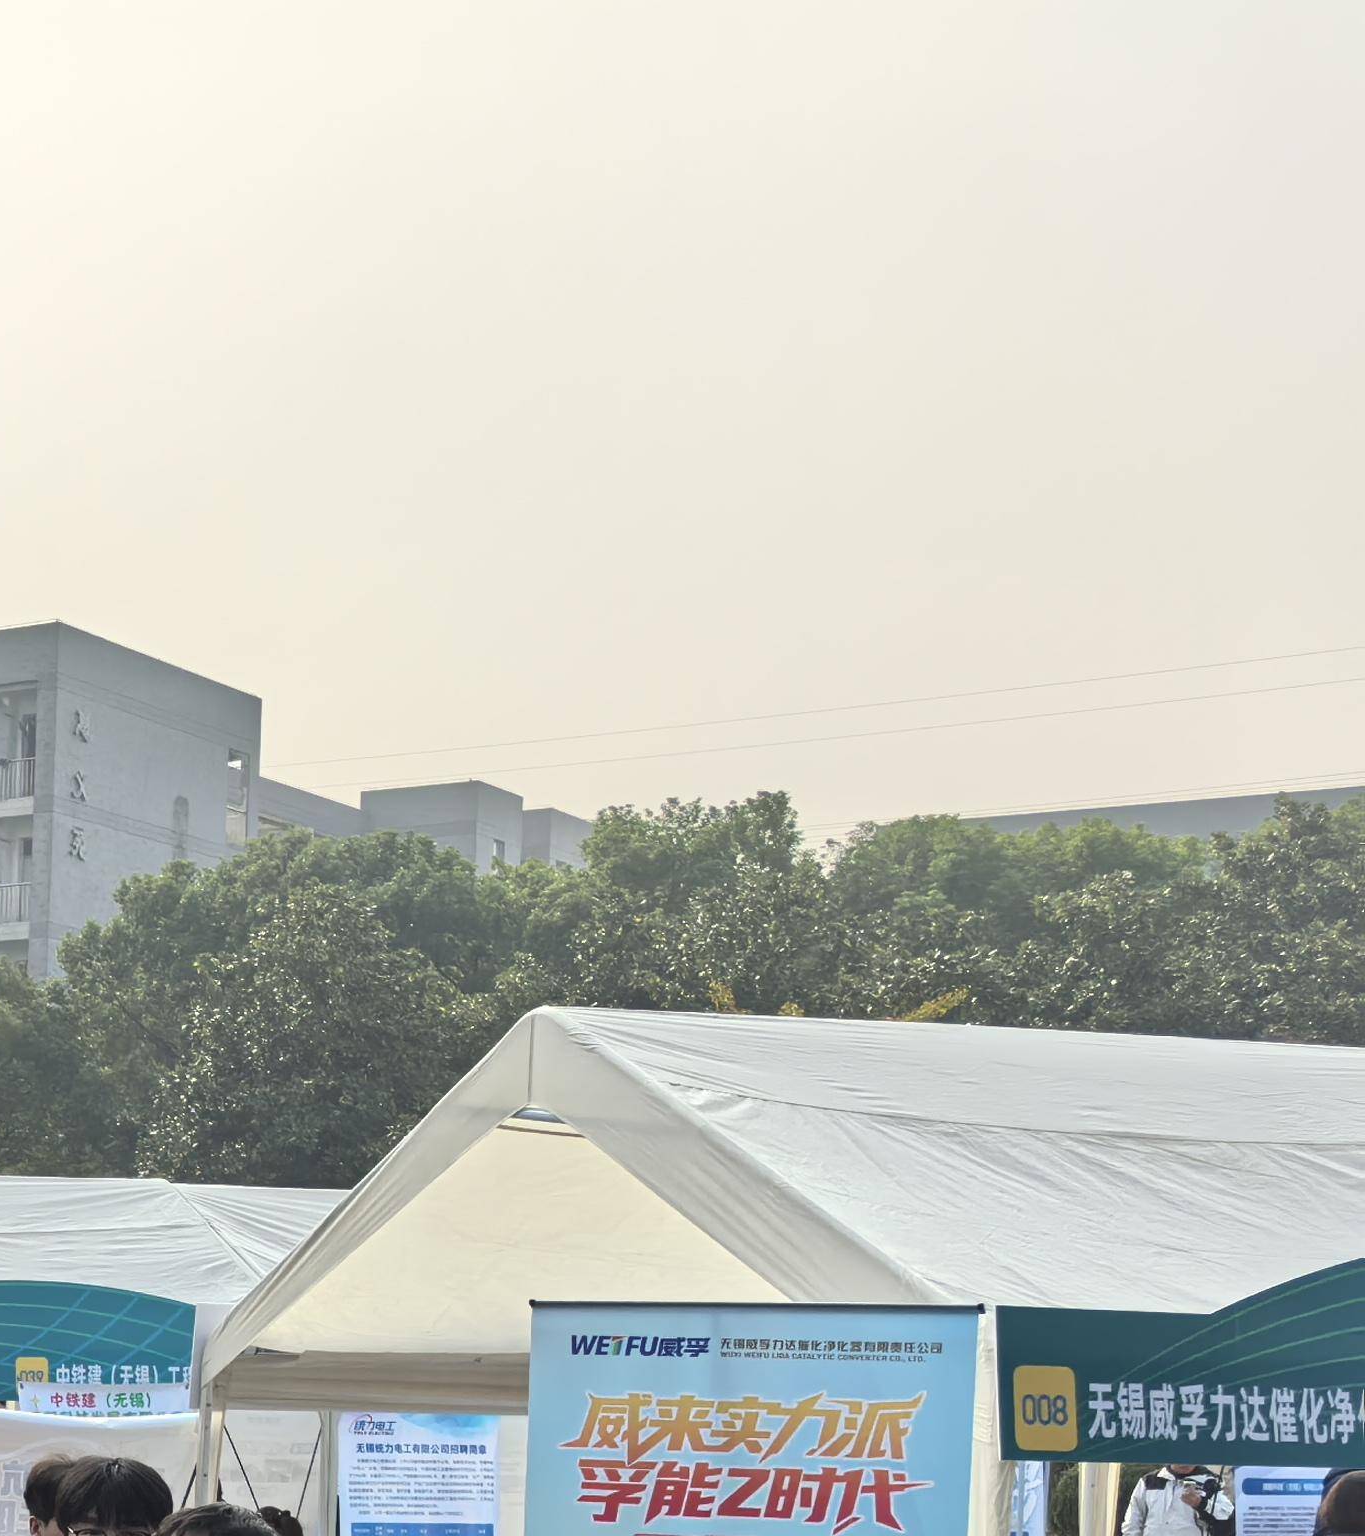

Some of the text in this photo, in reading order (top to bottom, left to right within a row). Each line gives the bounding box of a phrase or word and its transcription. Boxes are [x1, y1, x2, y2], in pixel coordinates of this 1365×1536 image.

[50, 1391, 152, 1409] 中铁建（无锡）
[559, 1390, 927, 1467] 威来实力派
[1022, 1394, 1069, 1426] 008
[1087, 1382, 1365, 1445] 无锡威孚力达催化净
[575, 1459, 935, 1536] 孚能Z时代
